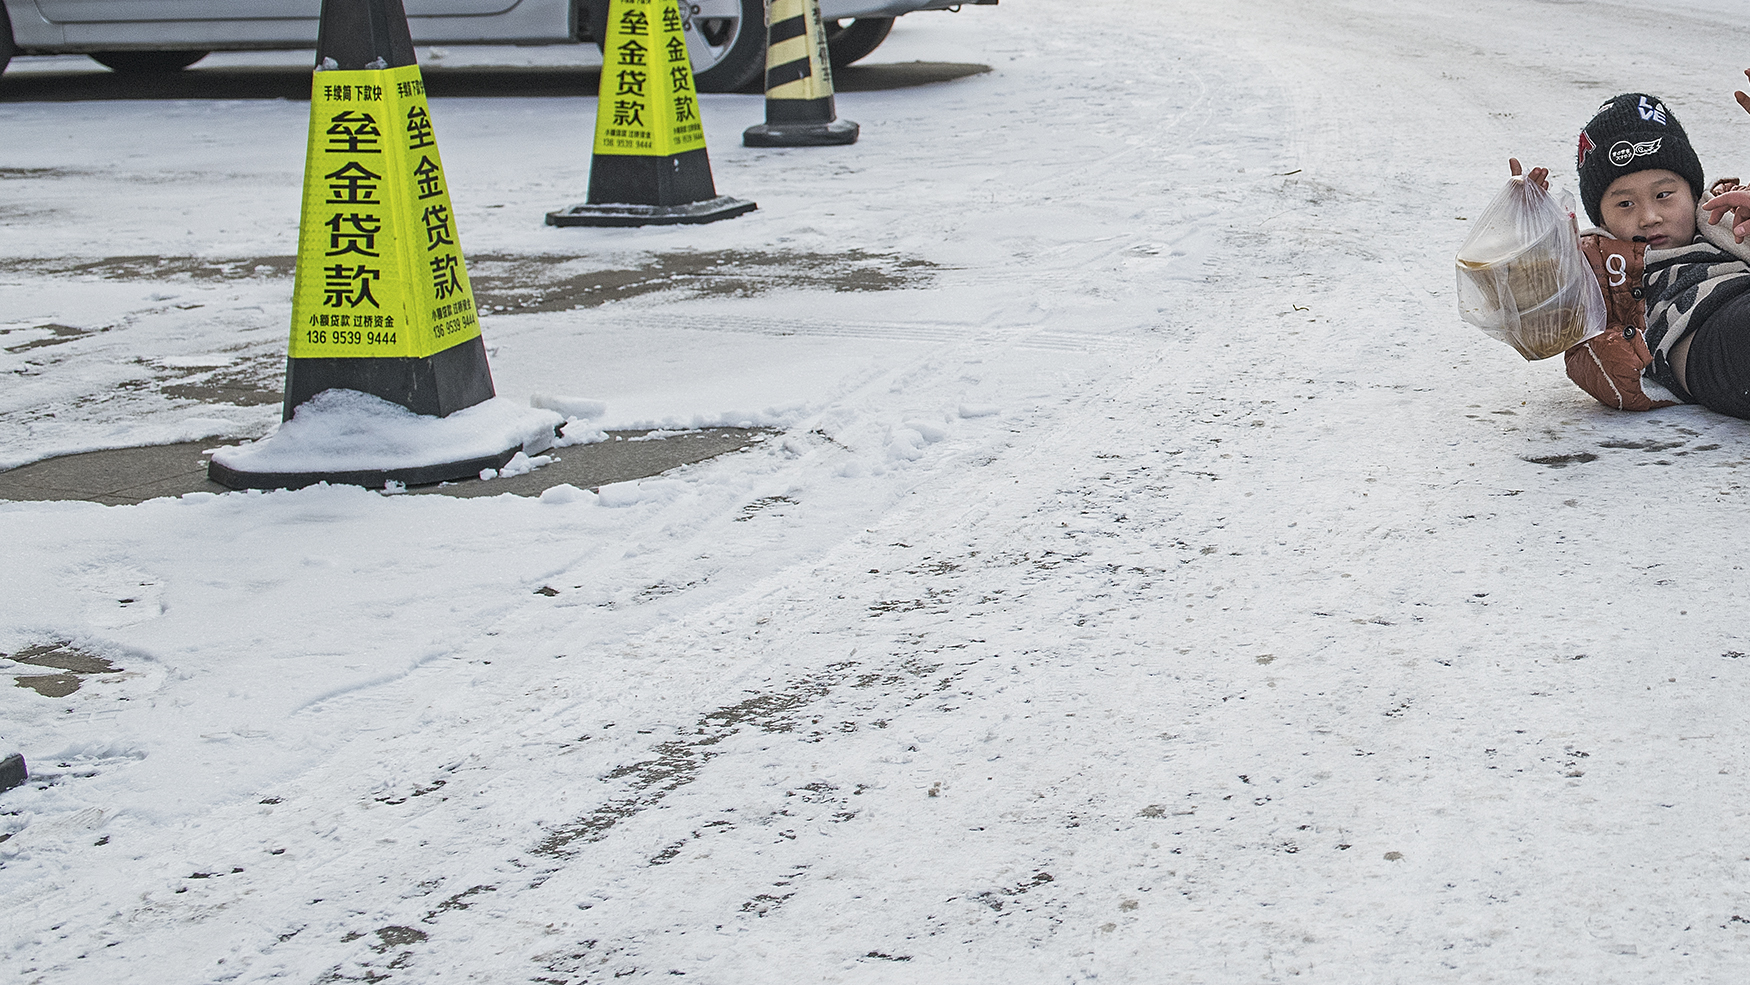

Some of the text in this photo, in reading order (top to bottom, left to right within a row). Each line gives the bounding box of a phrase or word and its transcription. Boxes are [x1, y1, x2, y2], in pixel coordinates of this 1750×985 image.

[613, 9, 649, 127] 垒金贷款
[662, 5, 696, 123] 垒金贷款
[324, 85, 383, 102] 手续简 下款快
[323, 110, 382, 309] 垒金贷款
[407, 105, 463, 300] 垒金贷款
[1605, 253, 1627, 287] 9
[306, 330, 397, 345] 136 9539 9444
[309, 314, 394, 328] 小额贷款 过桥资金
[433, 316, 476, 339] 136 9539 9444
